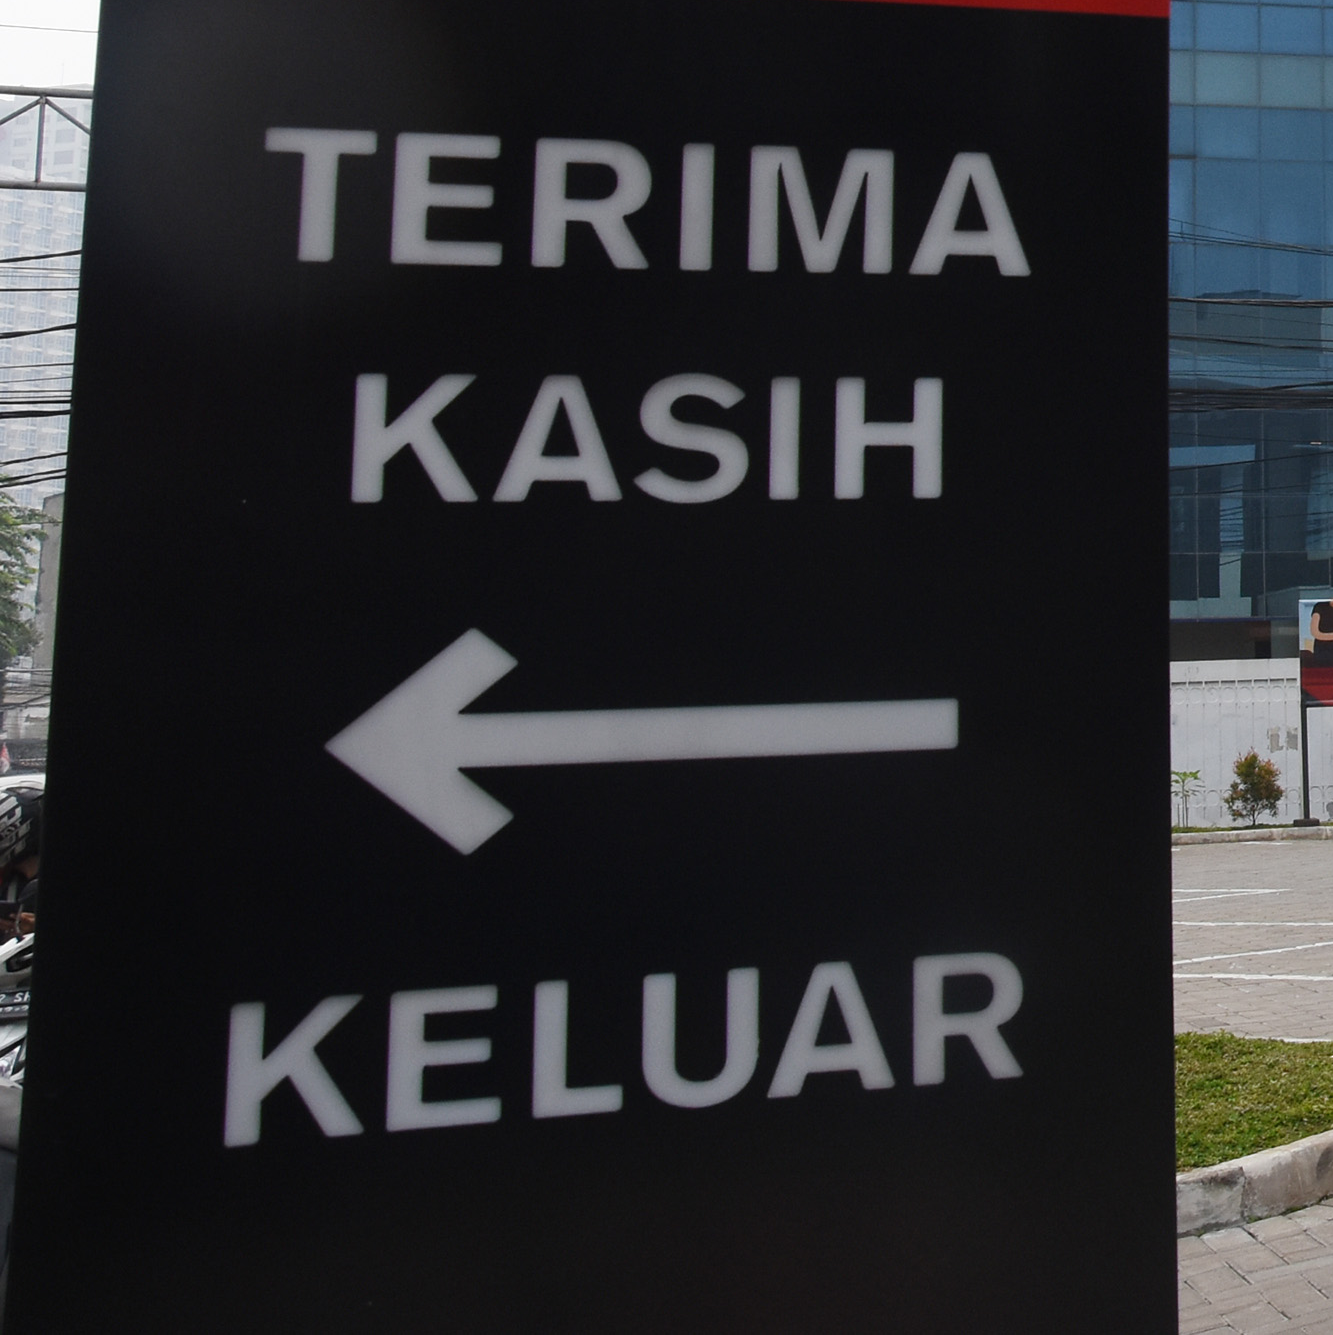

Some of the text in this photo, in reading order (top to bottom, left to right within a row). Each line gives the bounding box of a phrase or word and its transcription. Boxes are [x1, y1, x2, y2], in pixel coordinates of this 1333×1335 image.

[265, 128, 1031, 276] TERIMA
[350, 373, 943, 503] KASIH
[223, 952, 1025, 1147] KELUAR
